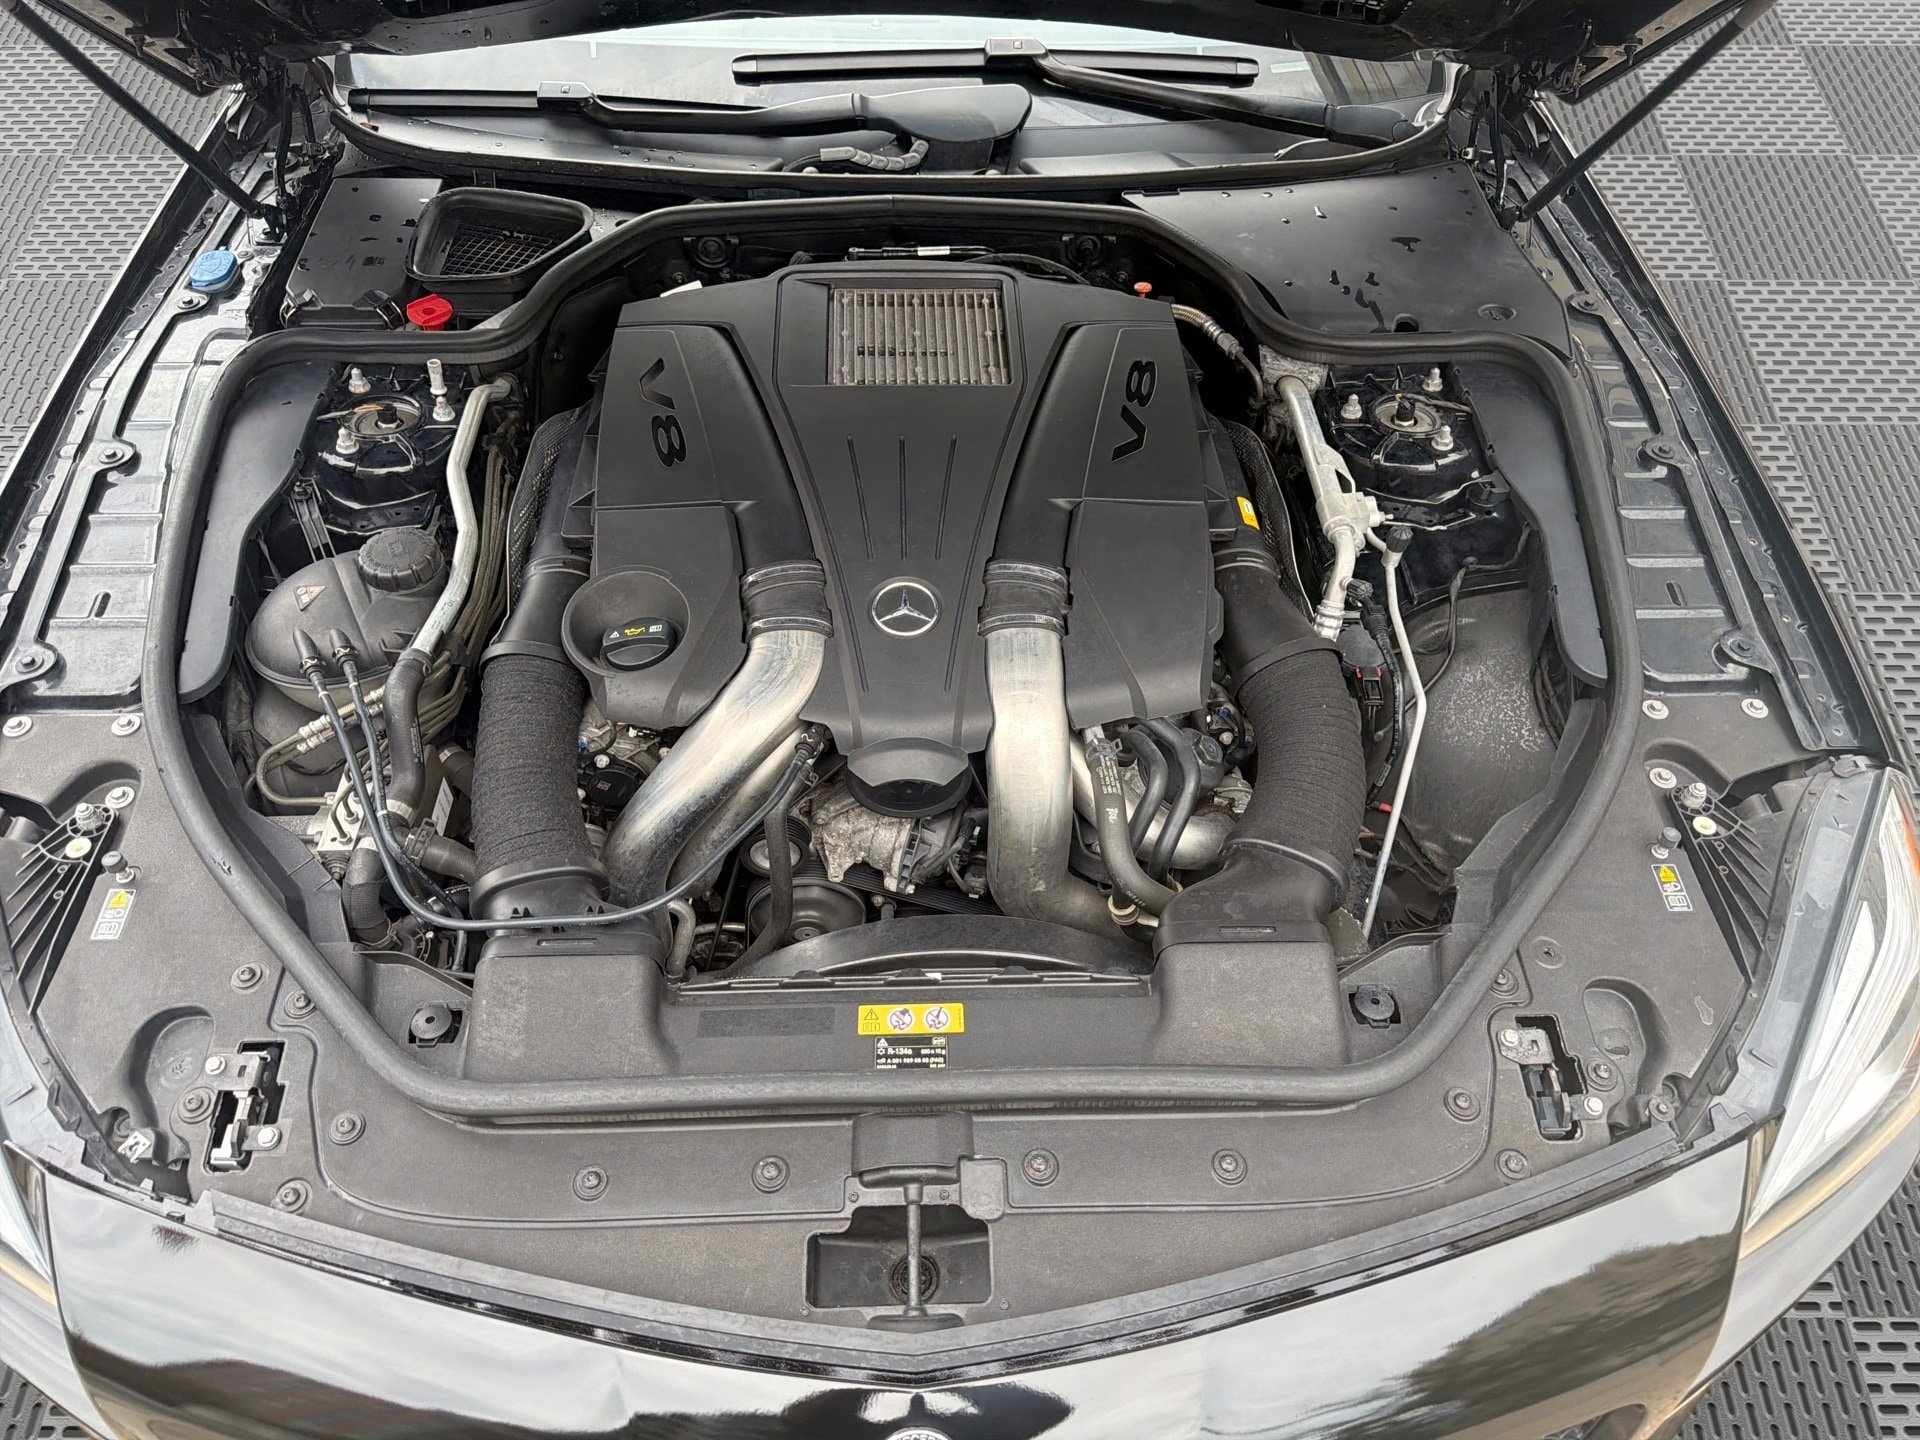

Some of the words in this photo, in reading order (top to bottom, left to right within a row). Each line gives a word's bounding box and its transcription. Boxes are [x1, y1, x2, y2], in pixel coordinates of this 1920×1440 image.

[639, 357, 687, 467] V8
[1111, 360, 1157, 462] V8
[888, 1047, 912, 1055] R-134a
